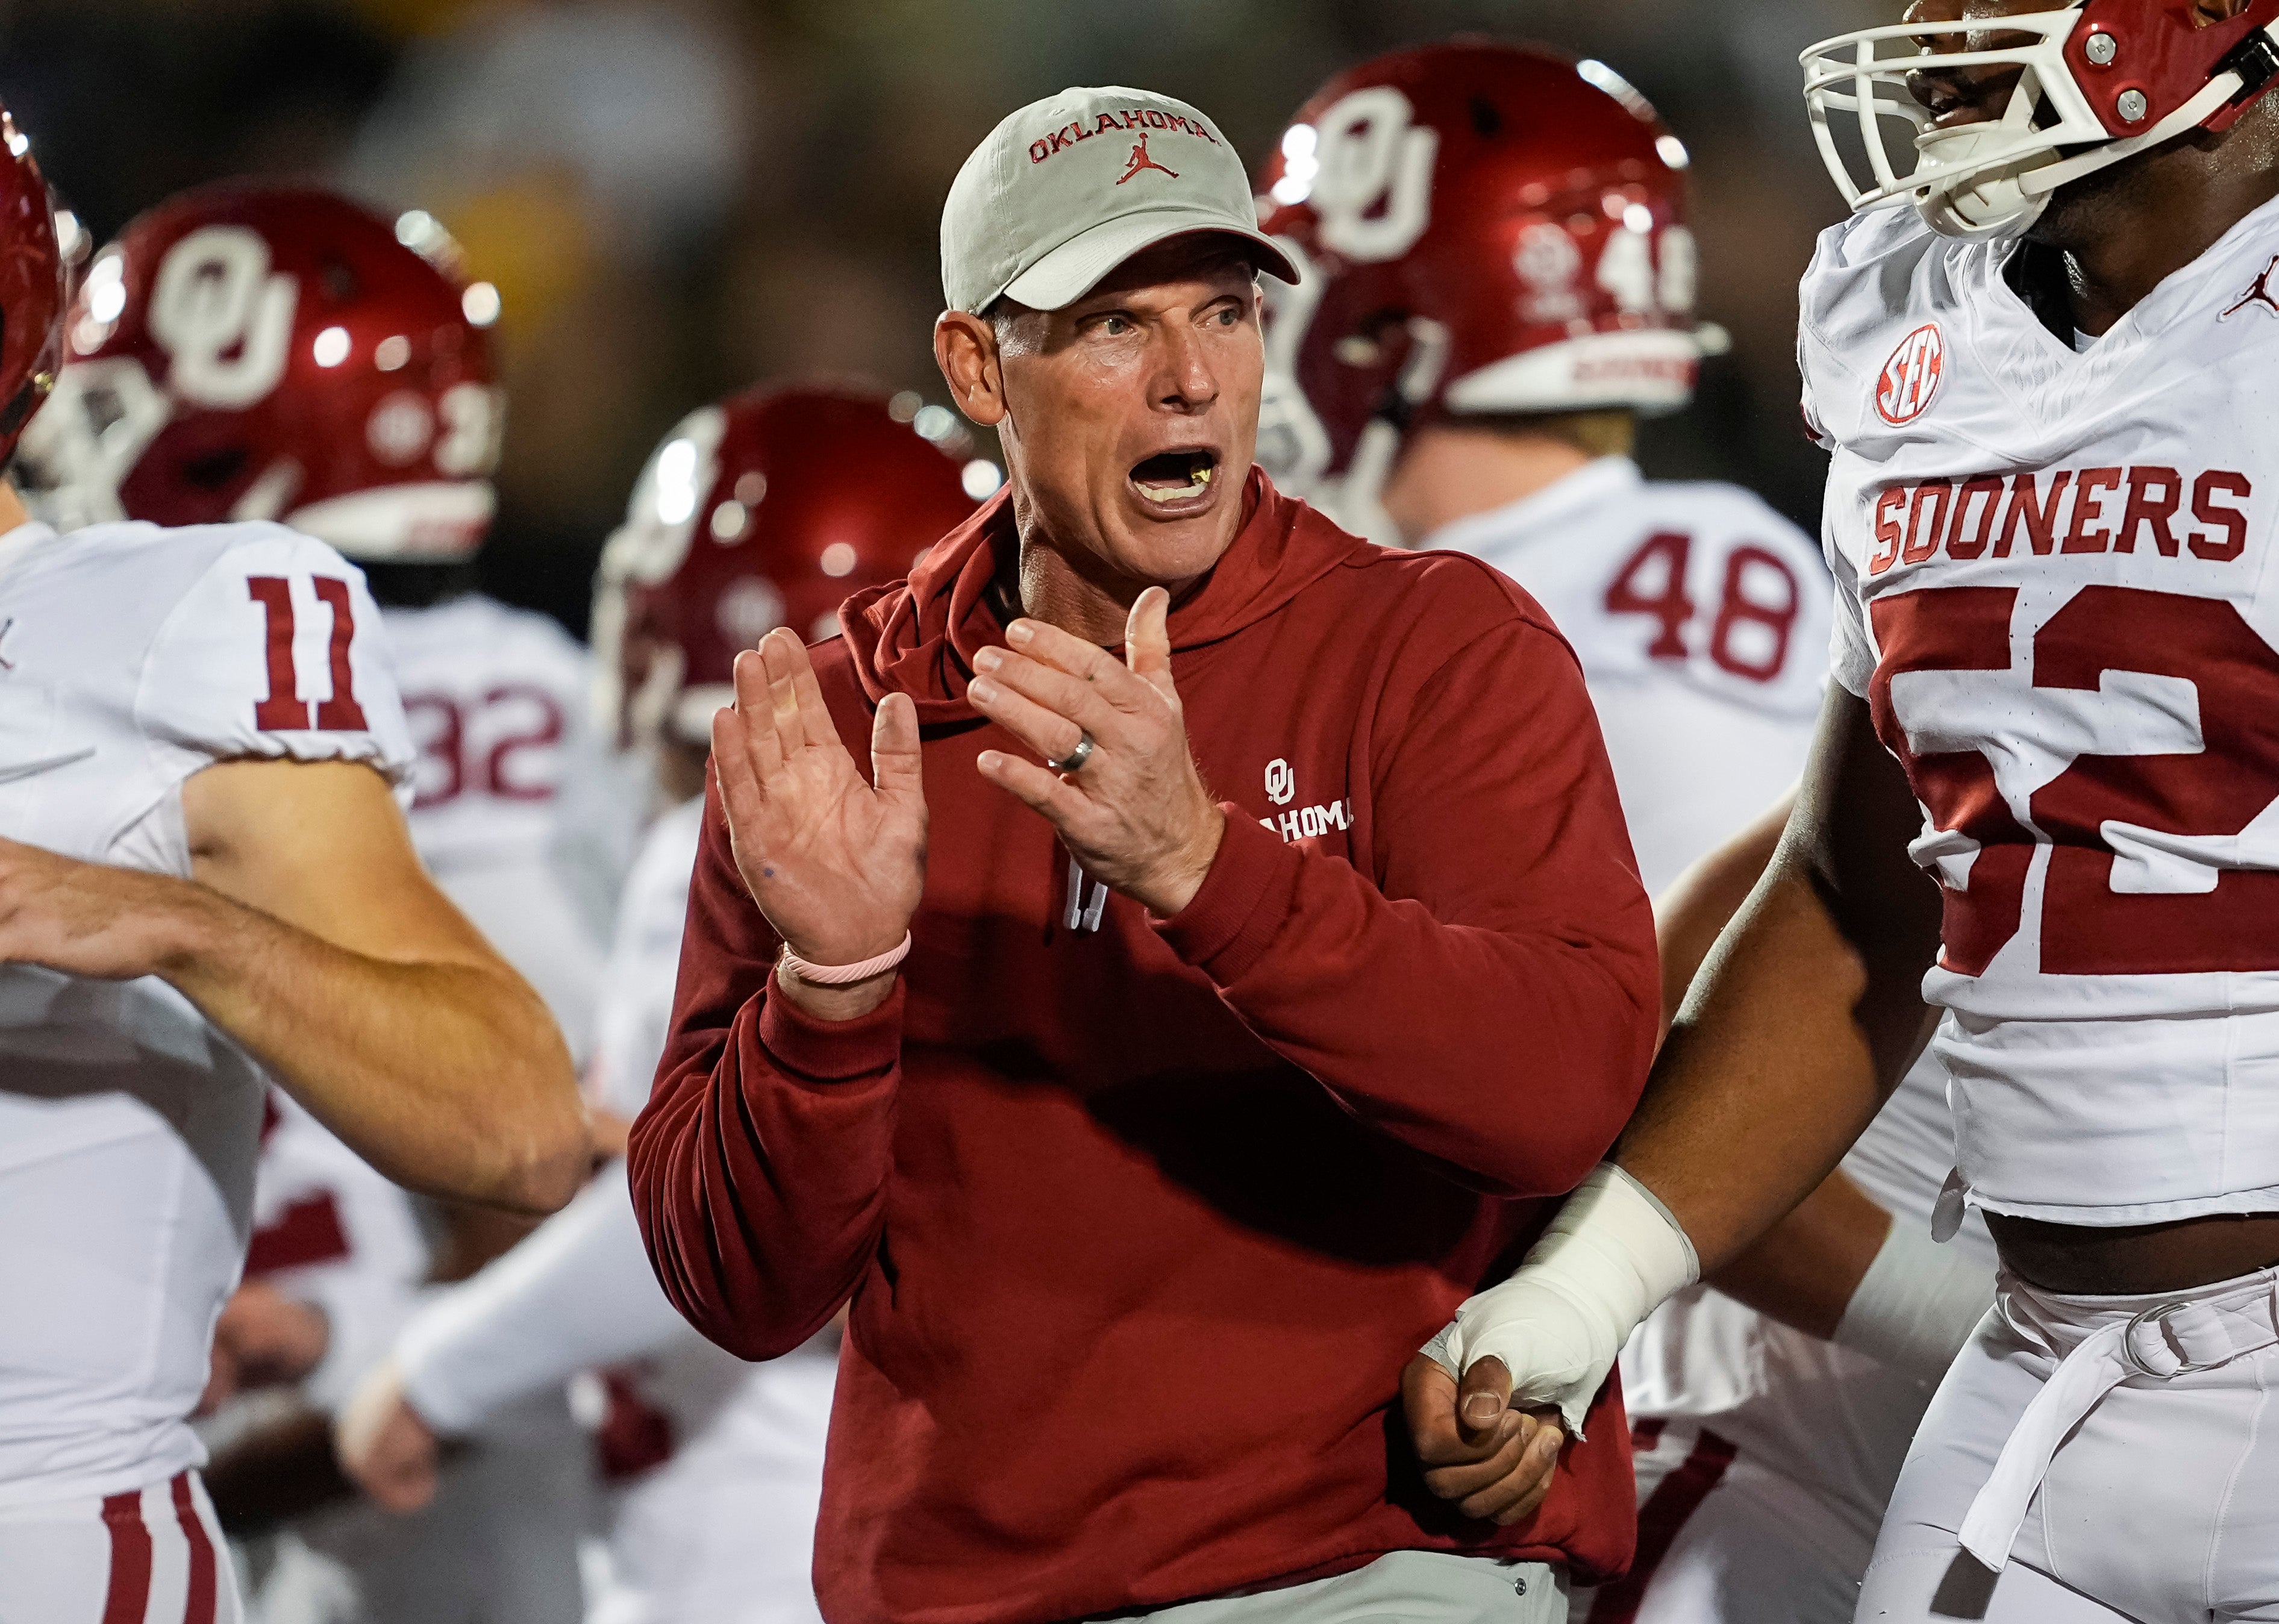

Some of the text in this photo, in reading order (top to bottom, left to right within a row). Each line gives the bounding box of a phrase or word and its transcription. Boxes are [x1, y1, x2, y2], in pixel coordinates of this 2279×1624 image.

[1029, 110, 1222, 164] OKLAHOMA
[1307, 86, 1440, 263] OU
[149, 224, 300, 410] OU
[1878, 328, 1941, 418] SEC
[1869, 466, 2251, 575] SOONERS
[247, 575, 369, 731] 11
[1605, 530, 1798, 682] 48
[401, 682, 566, 810] 32
[1265, 758, 1295, 805] OU
[1868, 584, 2279, 977] 52
